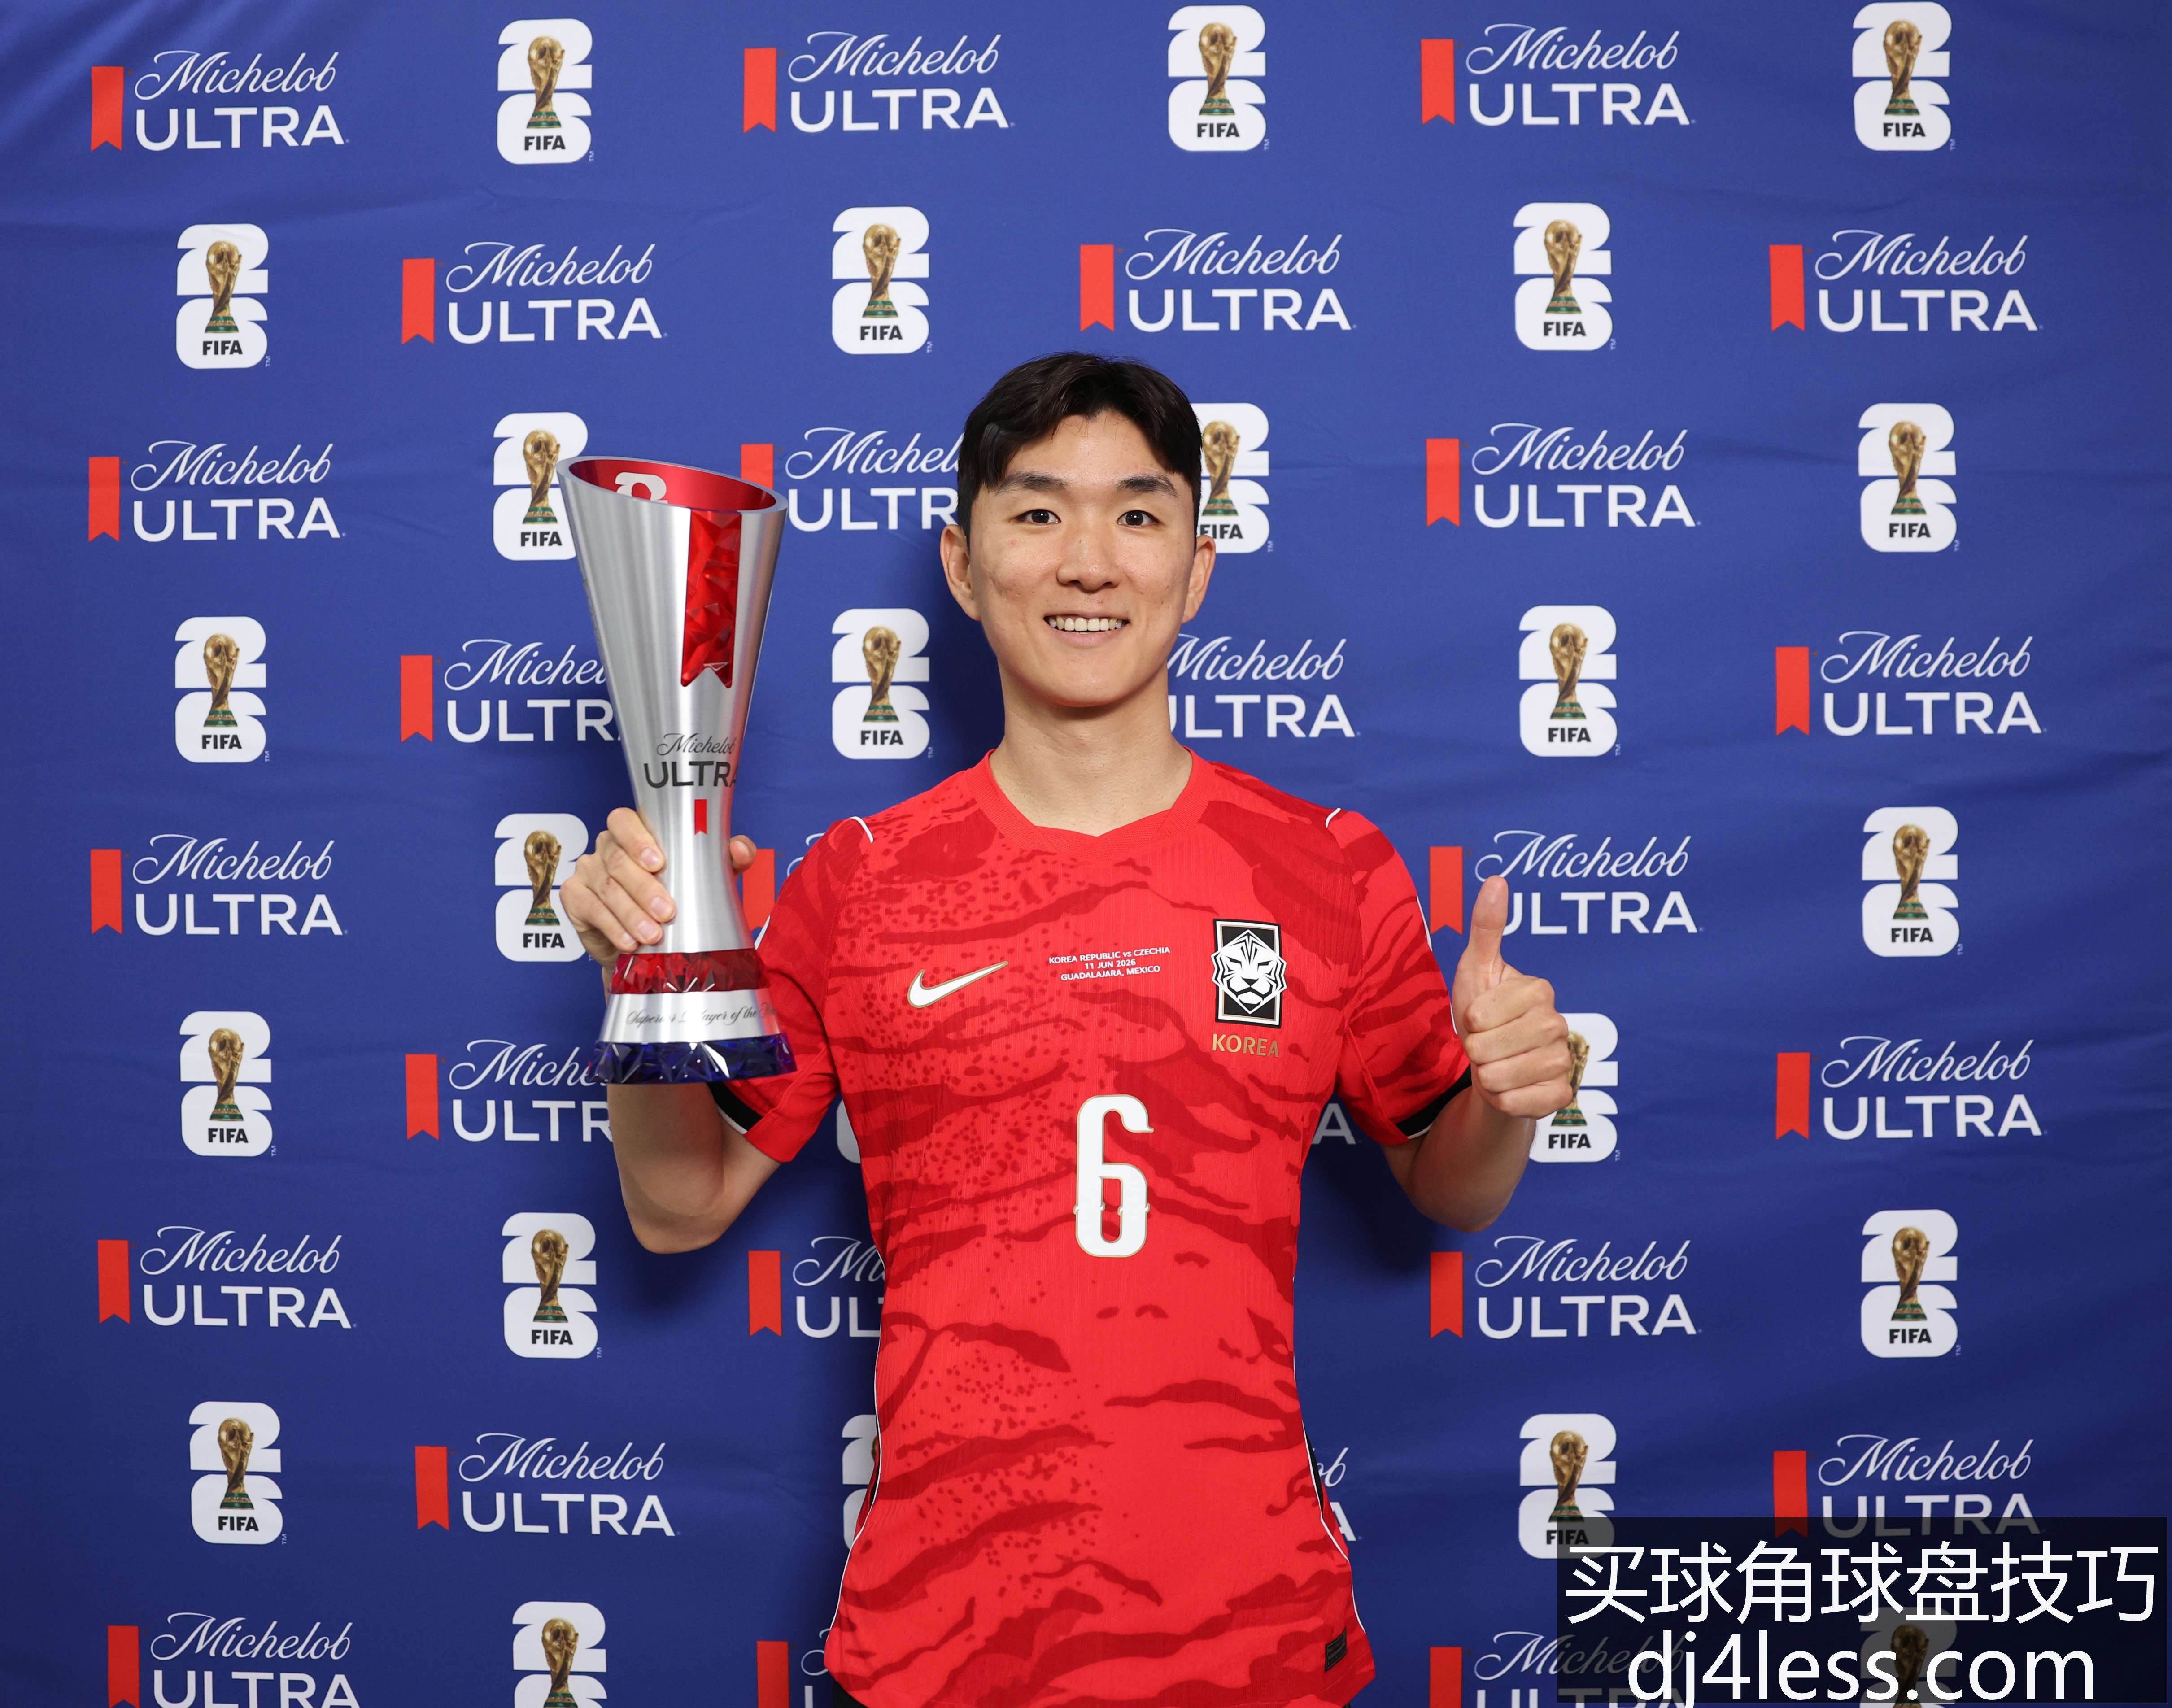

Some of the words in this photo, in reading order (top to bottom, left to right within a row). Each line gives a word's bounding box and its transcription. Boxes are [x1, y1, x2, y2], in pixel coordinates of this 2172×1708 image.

[788, 31, 1001, 83] Michelob
[1466, 24, 1679, 74] Michelob
[135, 50, 339, 100] Michelob
[791, 87, 1009, 133] ULTRA
[1470, 83, 1690, 126] ULTRA
[136, 105, 344, 151] ULTRA
[524, 135, 566, 151] FIFA
[1197, 123, 1239, 137] FIFA
[1883, 122, 1925, 137] FIFA
[446, 242, 655, 293] Michelob
[1125, 229, 1342, 280] Michelob
[1815, 230, 2028, 280] Michelob
[449, 298, 662, 344] ULTRA
[1129, 288, 1351, 332] ULTRA
[1544, 322, 1586, 336] FIFA
[1819, 289, 2037, 332] ULTRA
[203, 340, 243, 355] FIFA
[860, 326, 903, 340] FIFA
[131, 440, 333, 491] Michelob
[785, 427, 964, 479] Michel
[1472, 423, 1687, 475] Michelob
[134, 497, 340, 542] ULTRA
[789, 487, 959, 532] ULTR
[1475, 484, 1696, 528] ULTRA
[521, 532, 562, 546] FIFA
[1199, 523, 1244, 540] FIFA
[1889, 523, 1931, 538] FIFA
[444, 639, 606, 691] Miche
[1167, 633, 1347, 680] Michelob
[1821, 631, 2032, 683] Michelob
[447, 699, 620, 743] ULTR
[1548, 728, 1591, 742] FIFA
[1824, 692, 2041, 736] ULTRA
[202, 734, 242, 749] FIFA
[861, 730, 903, 745] FIFA
[133, 834, 334, 884] Michelob
[1474, 830, 1691, 883] Michelob
[136, 894, 343, 936] ULTRA
[1891, 928, 1933, 943] FIFA
[523, 933, 565, 948] FIFA
[1049, 955, 1078, 964] KOREA
[1080, 951, 1121, 962] REPUBLIC
[1133, 947, 1170, 956] CZECHIA
[1060, 969, 1124, 981] GUADALAJARA,
[1126, 965, 1160, 975] MEXICO
[1097, 961, 1114, 969] JUN
[1116, 959, 1136, 967] 2026
[724, 1006, 748, 1025] of
[743, 1006, 757, 1019] the
[1212, 1033, 1278, 1058] KOREA
[1821, 1036, 2033, 1088] Michelob
[208, 1128, 249, 1143] FIFA
[453, 1099, 613, 1143] ULTR
[1824, 1094, 2042, 1140] ULTRA
[1548, 1133, 1591, 1149] FIFA
[1073, 1094, 1154, 1257] 6
[140, 1226, 342, 1275] Michelob
[1476, 1236, 1690, 1287] Michelob
[144, 1285, 351, 1329] ULTRA
[1479, 1294, 1697, 1339] ULTRA
[532, 1329, 573, 1345] FIFA
[1889, 1329, 1932, 1344] FIFA
[459, 1433, 665, 1481] Michelob
[1819, 1435, 2033, 1486] Michelob
[218, 1516, 259, 1531] FIFA
[462, 1491, 675, 1536] ULTRA
[1822, 1494, 2041, 1538] ULTRA
[1545, 1529, 1590, 1545] FIFA
[151, 1612, 352, 1660] Michelob
[154, 1670, 360, 1708] ULTRA
